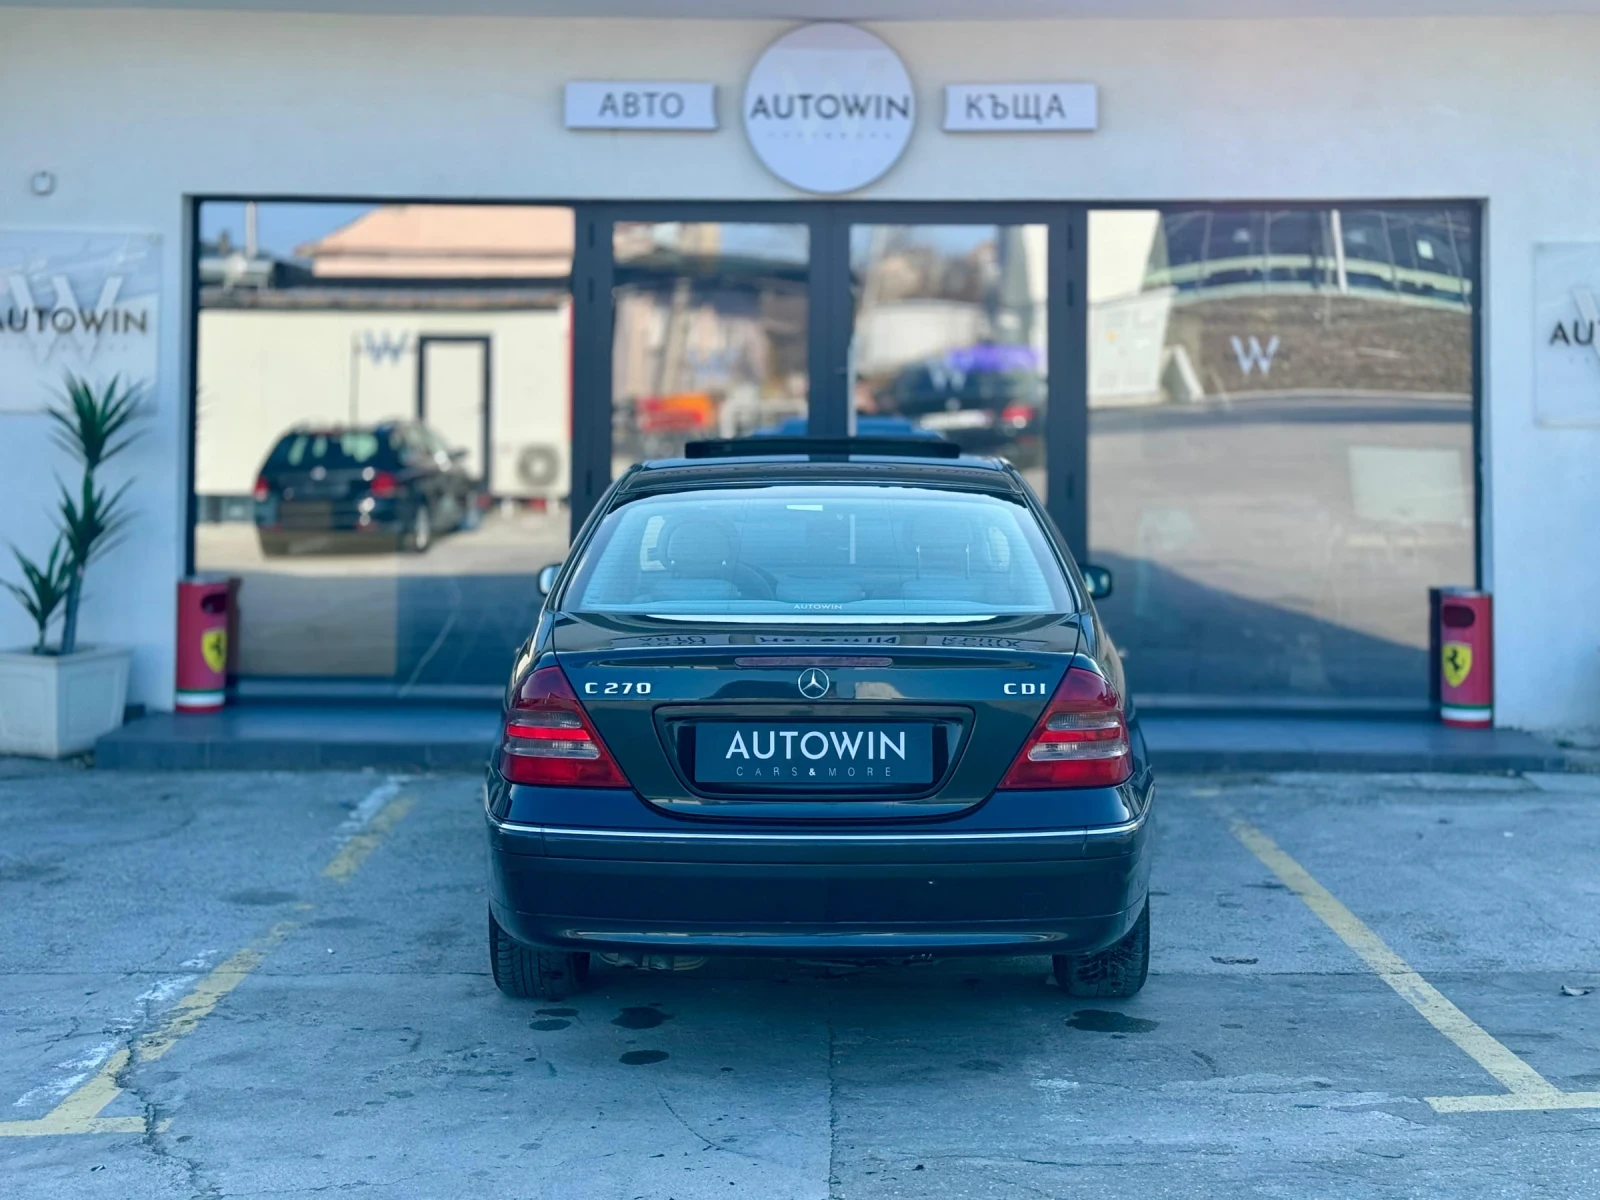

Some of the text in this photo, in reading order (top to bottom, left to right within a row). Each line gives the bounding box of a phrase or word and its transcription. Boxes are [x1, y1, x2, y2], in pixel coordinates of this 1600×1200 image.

[598, 91, 685, 120] АВТО
[749, 93, 911, 120] AUTOWIN
[965, 92, 1067, 124] КЪЩА
[1549, 317, 1600, 347] AU
[1228, 334, 1281, 377] W
[793, 603, 843, 611] AUTOWIN
[584, 681, 652, 695] C 270
[1003, 682, 1048, 696] CDI
[725, 730, 907, 761] AUTOWIN
